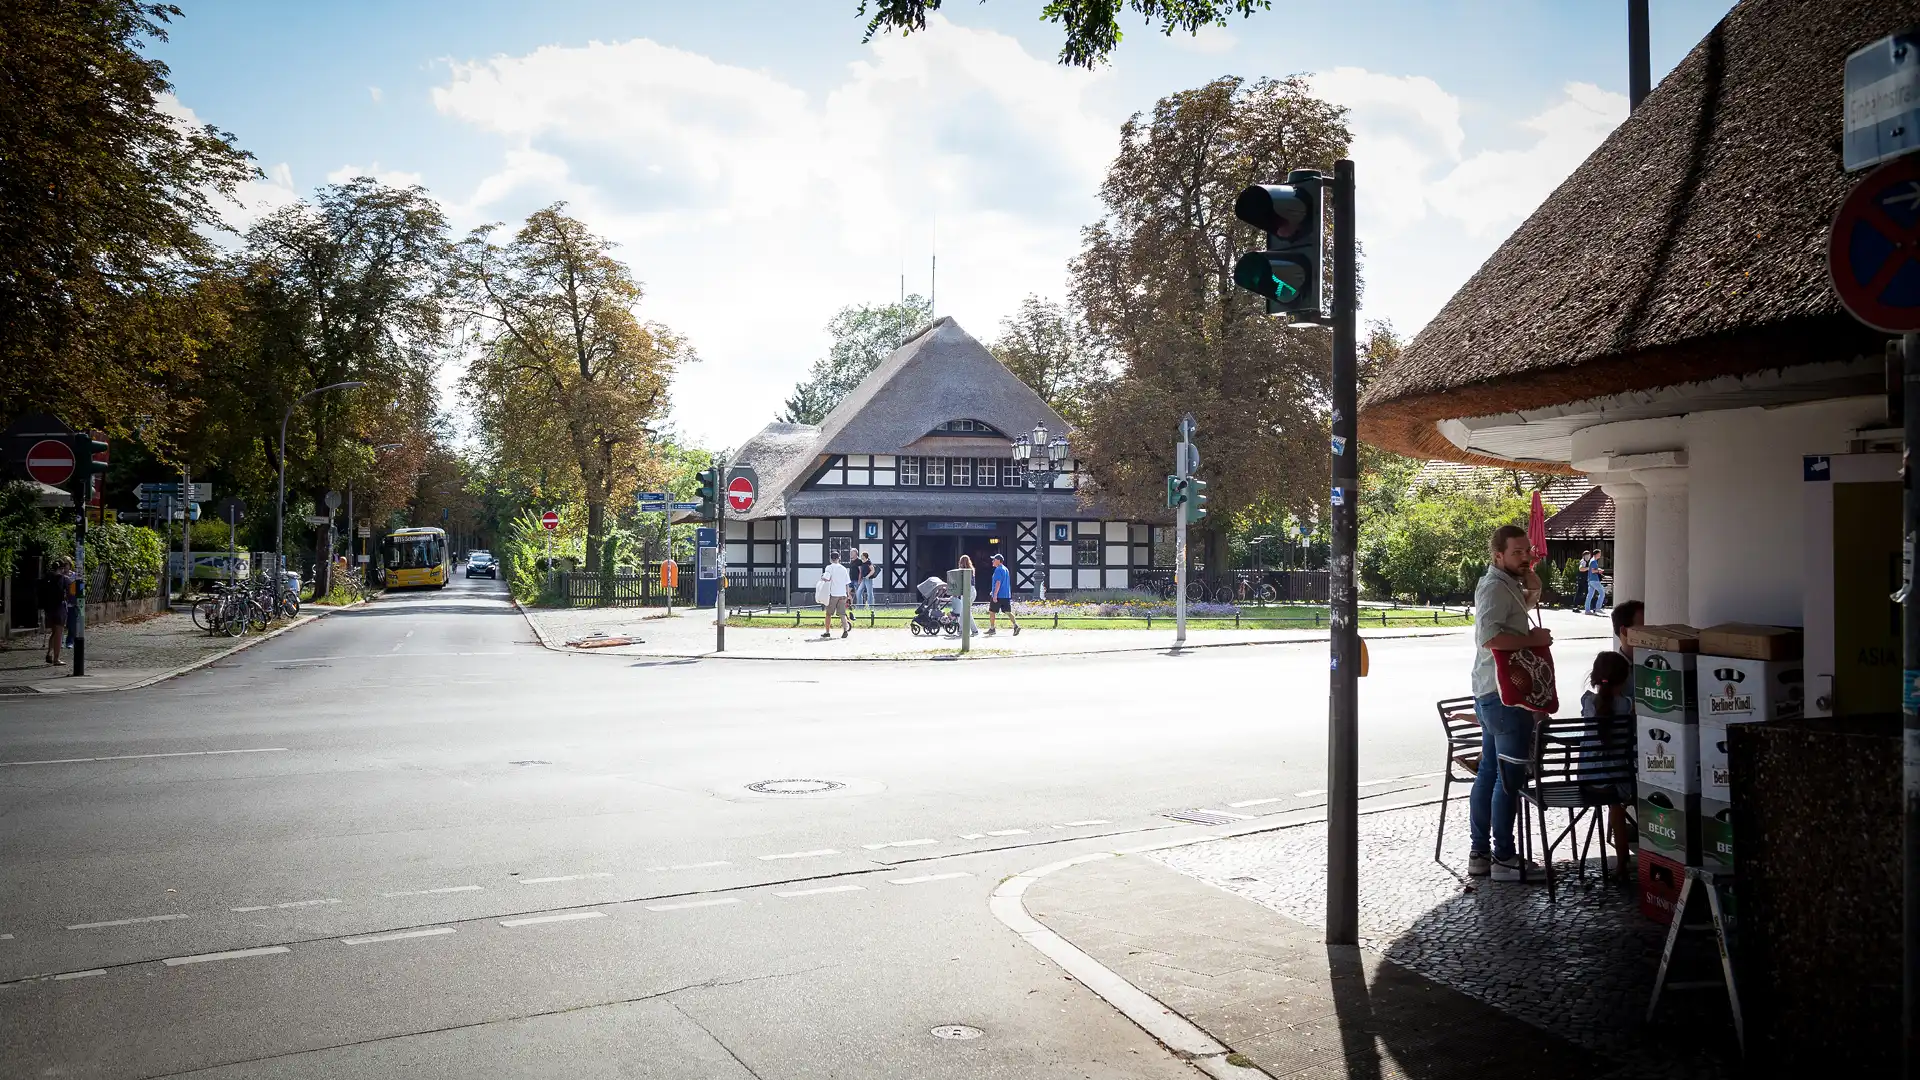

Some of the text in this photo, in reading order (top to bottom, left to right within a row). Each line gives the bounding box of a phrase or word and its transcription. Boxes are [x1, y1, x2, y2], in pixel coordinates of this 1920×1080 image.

[1850, 78, 1920, 124] Einbahnstra
[867, 525, 877, 536] U
[1058, 528, 1066, 538] U
[1857, 646, 1898, 667] ASIA
[1644, 686, 1673, 701] BECK'S
[1711, 696, 1751, 712] Berliner Kindl
[1647, 756, 1663, 769] Berliner
[1648, 822, 1676, 839] BECK'S
